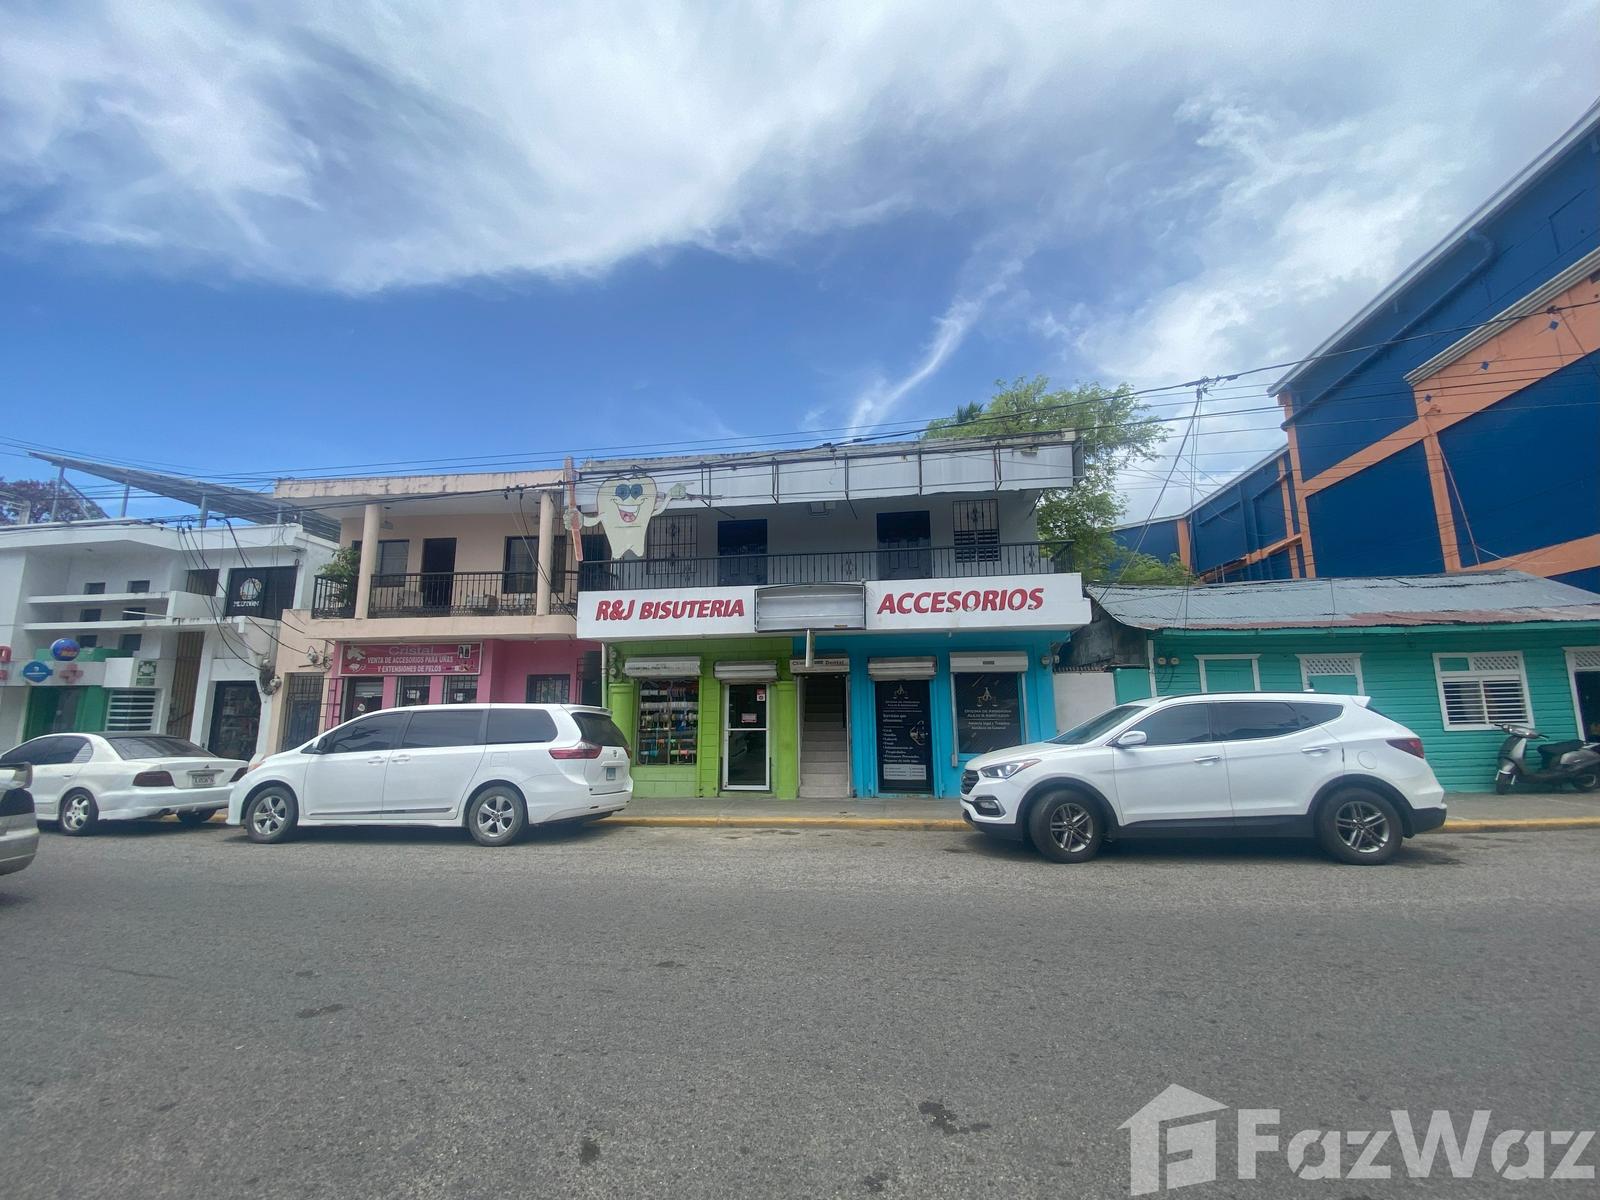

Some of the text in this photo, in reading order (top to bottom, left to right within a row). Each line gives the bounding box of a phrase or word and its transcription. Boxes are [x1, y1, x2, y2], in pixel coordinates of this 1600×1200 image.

[877, 588, 1044, 614] ACCESORIOS
[595, 598, 745, 621] R&J BISUTERIA
[388, 645, 434, 655] Cristal
[393, 656, 424, 664] ACCESORIOS
[377, 665, 382, 673] Y
[382, 665, 417, 673] EXTENSIONES
